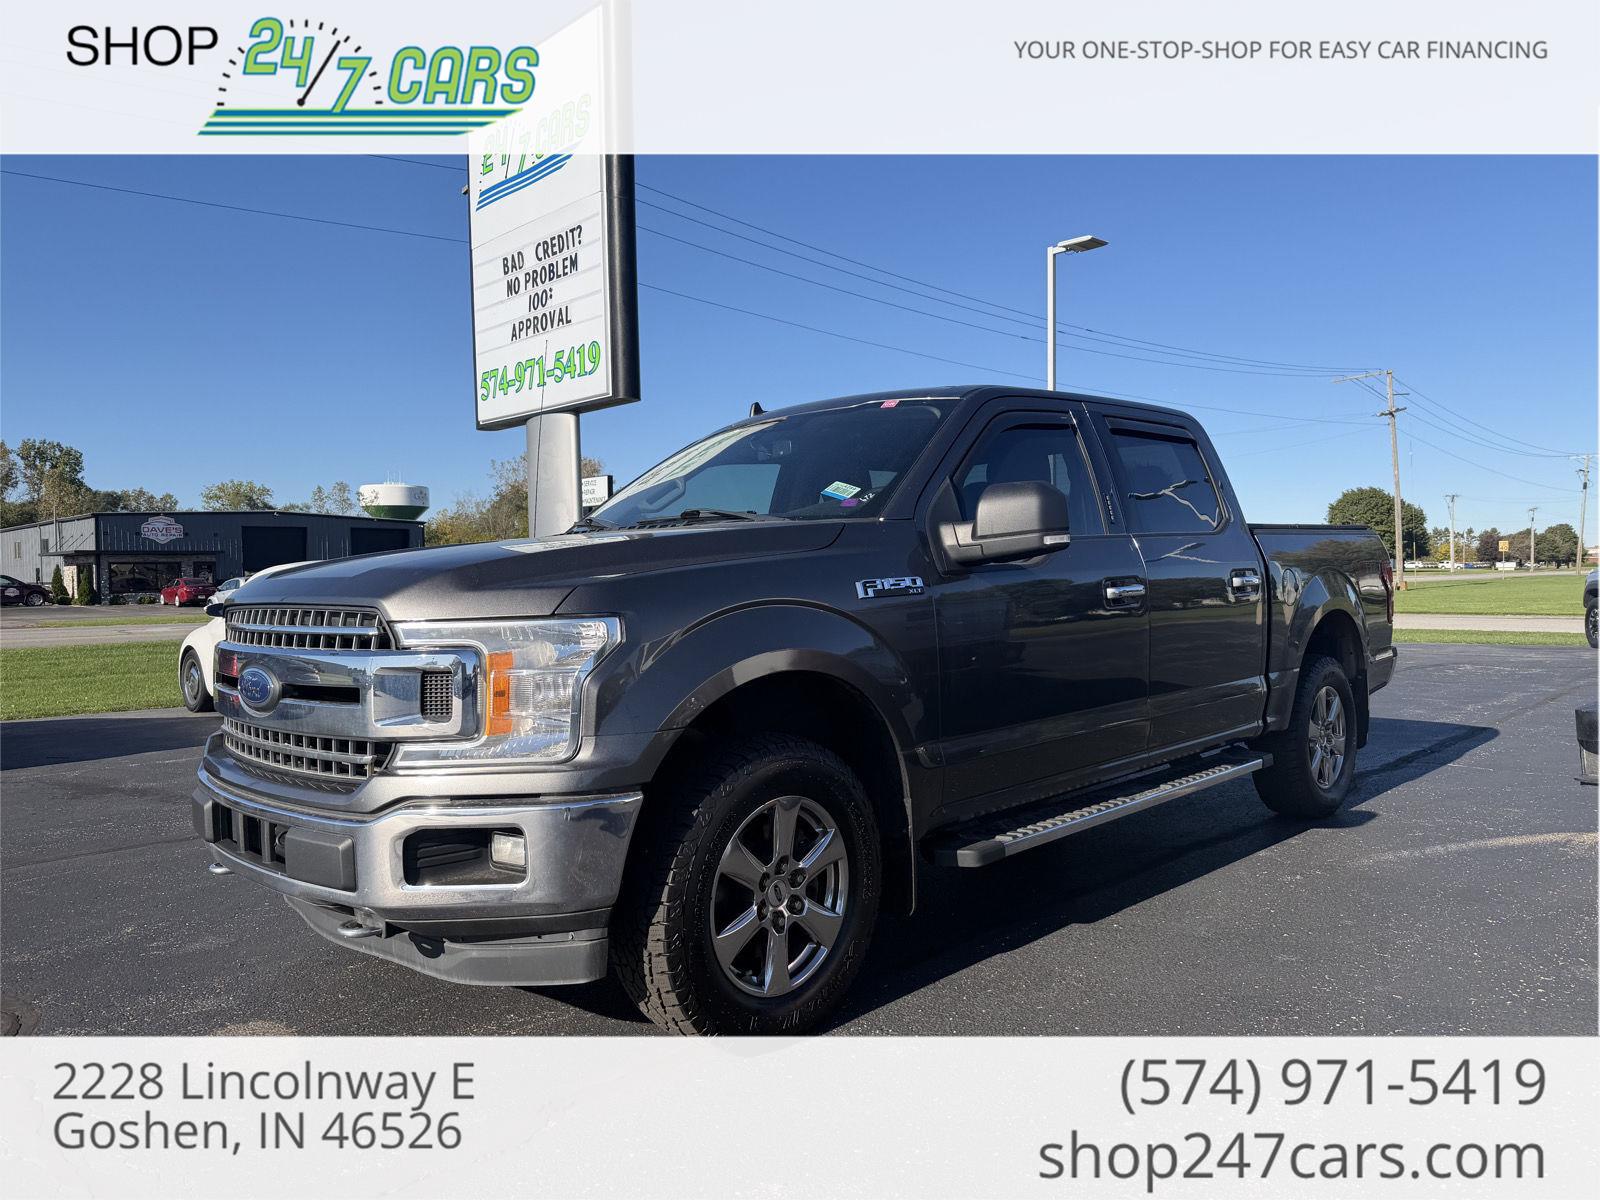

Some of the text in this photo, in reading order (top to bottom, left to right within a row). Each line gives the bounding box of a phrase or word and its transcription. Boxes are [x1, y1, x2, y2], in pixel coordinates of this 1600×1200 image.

[502, 224, 583, 276] BAD CREDIT?
[506, 252, 579, 298] NO PROBLEM
[510, 305, 572, 342] APPROVAL
[480, 340, 601, 402] 574-971-5419
